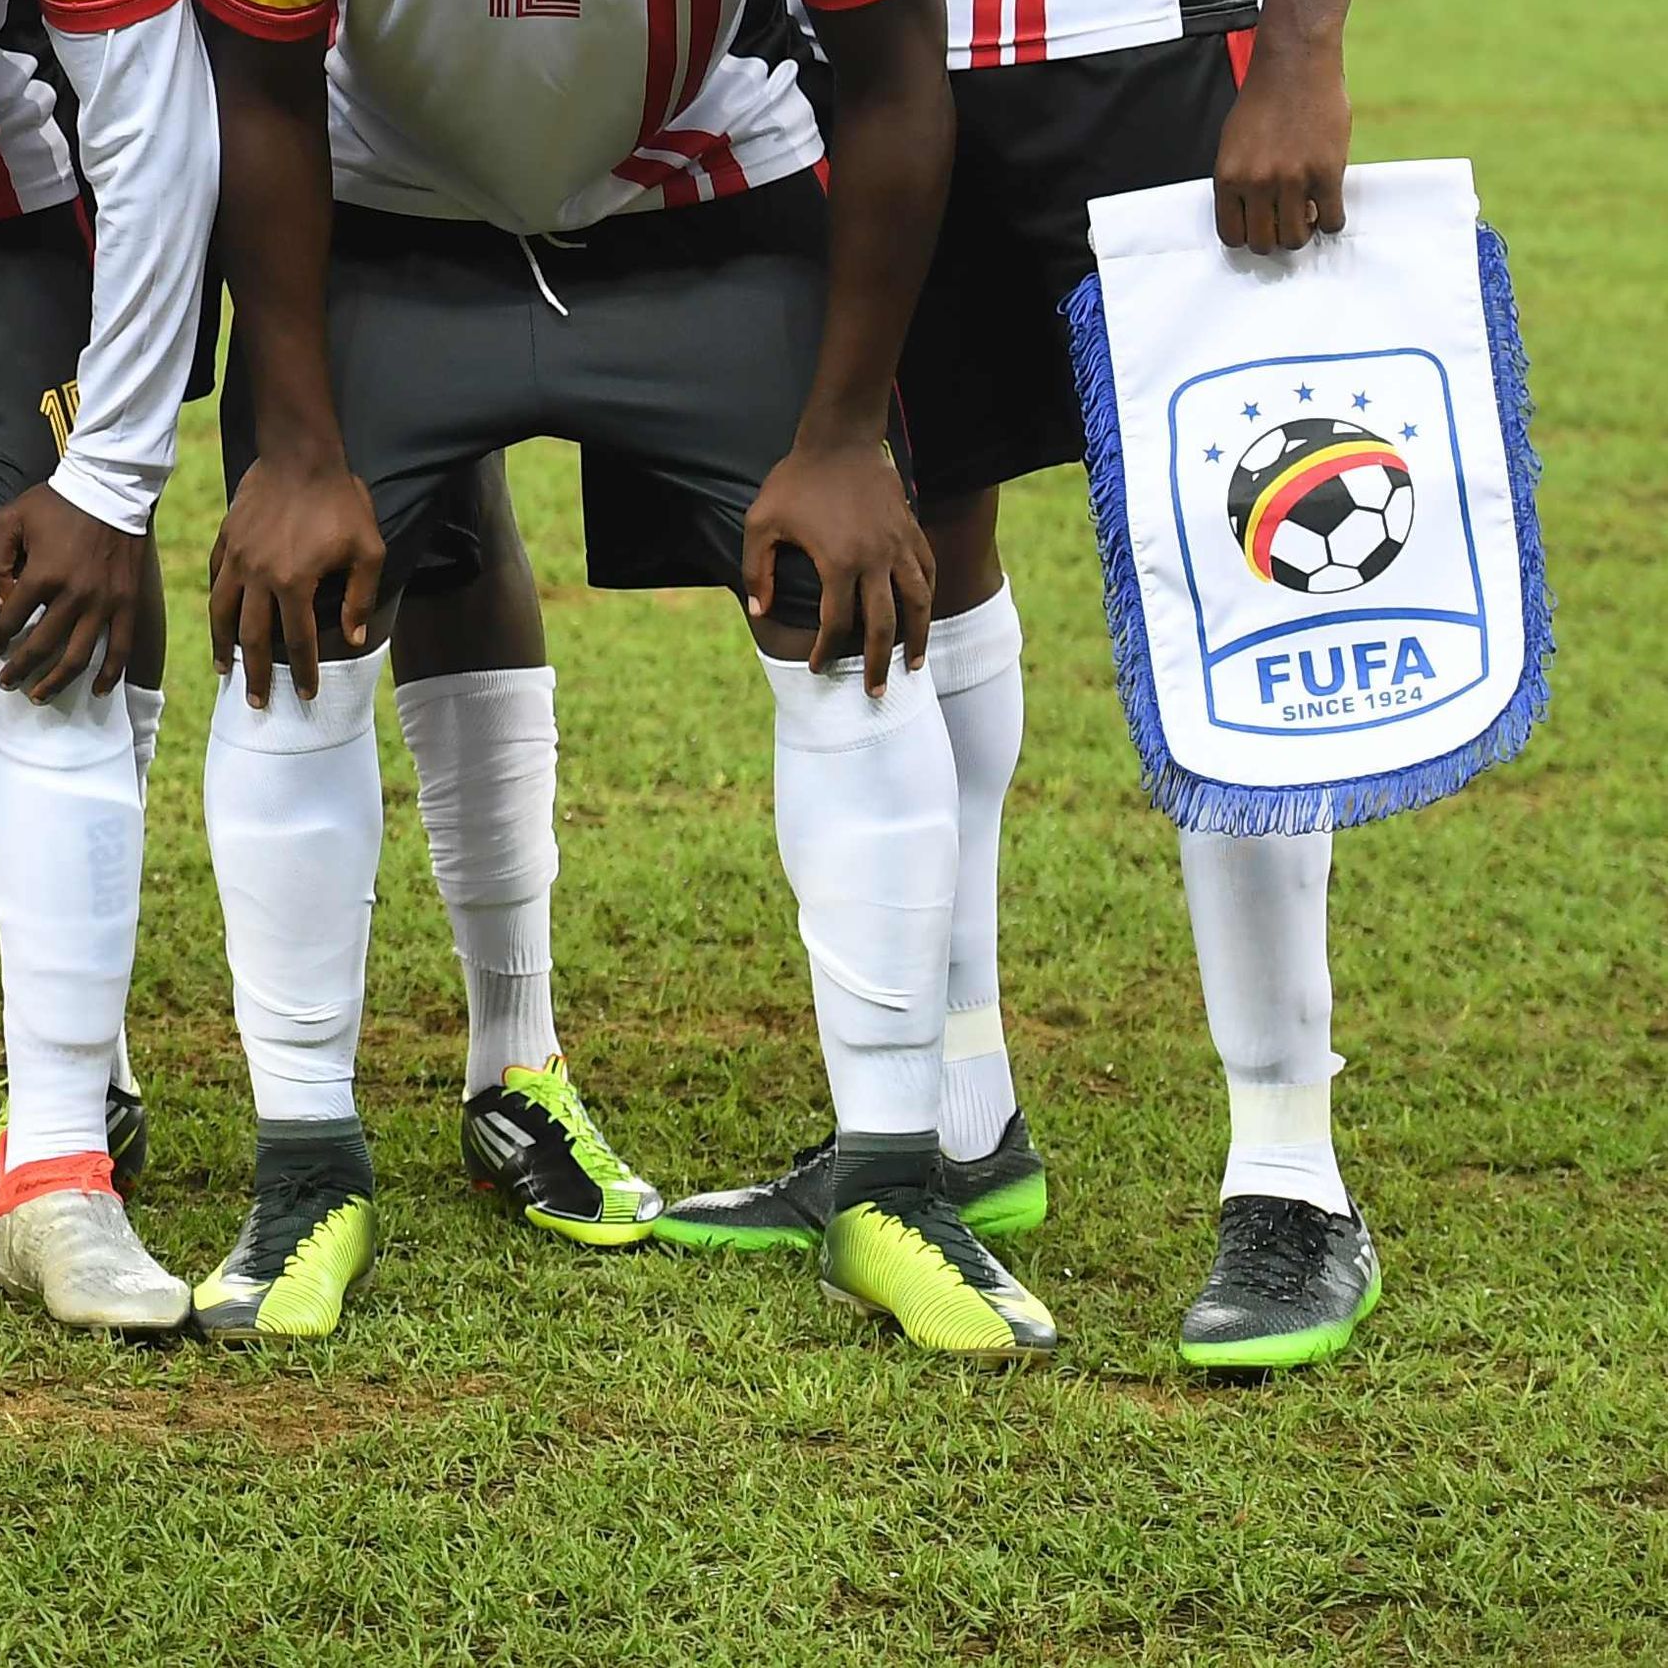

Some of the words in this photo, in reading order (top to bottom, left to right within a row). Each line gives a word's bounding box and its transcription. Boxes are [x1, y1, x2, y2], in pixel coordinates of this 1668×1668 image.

[1255, 635, 1436, 704] FUFA
[1282, 696, 1356, 722] SINCE
[1363, 686, 1423, 710] 1924
